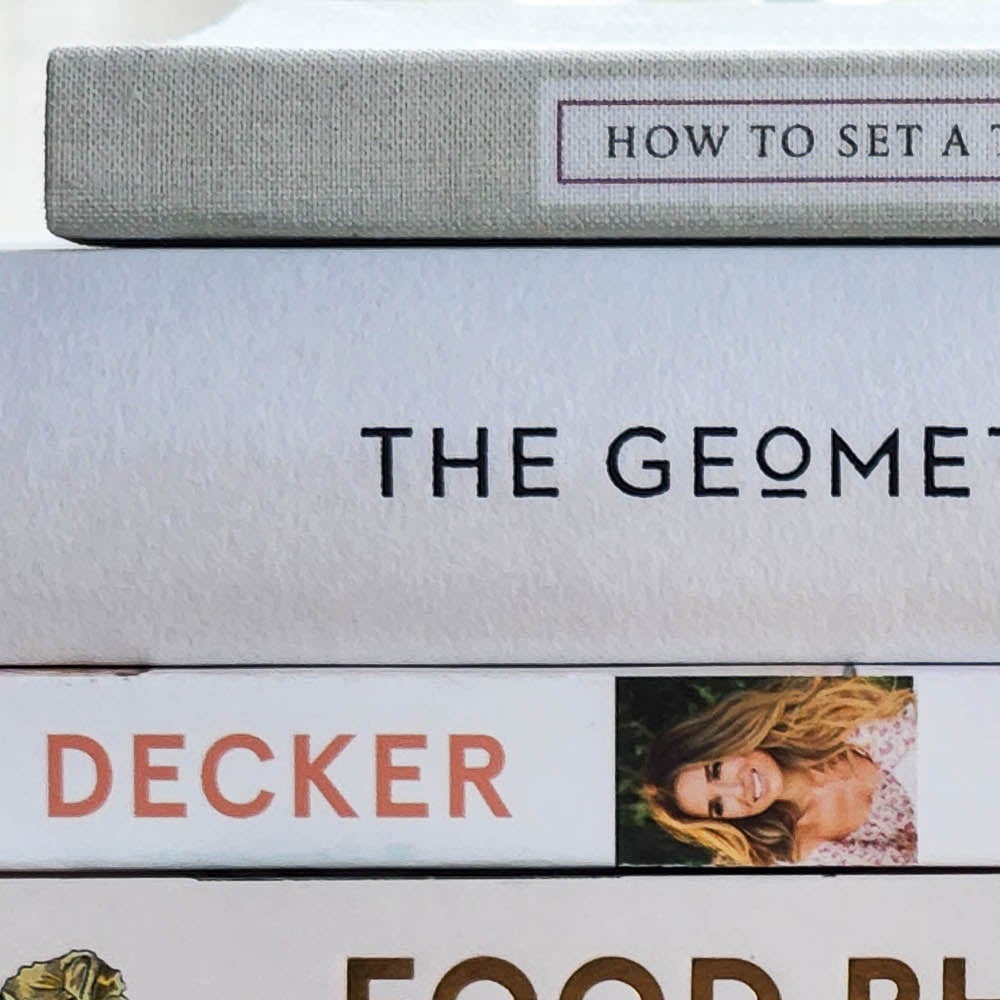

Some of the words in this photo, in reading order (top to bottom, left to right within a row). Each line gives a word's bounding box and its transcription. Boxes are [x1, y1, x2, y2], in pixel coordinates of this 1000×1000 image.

[608, 125, 729, 158] HOW
[751, 124, 814, 157] TO
[838, 124, 922, 158] SET
[942, 125, 969, 156] A
[361, 427, 559, 497] THE
[48, 734, 510, 818] DECKER
